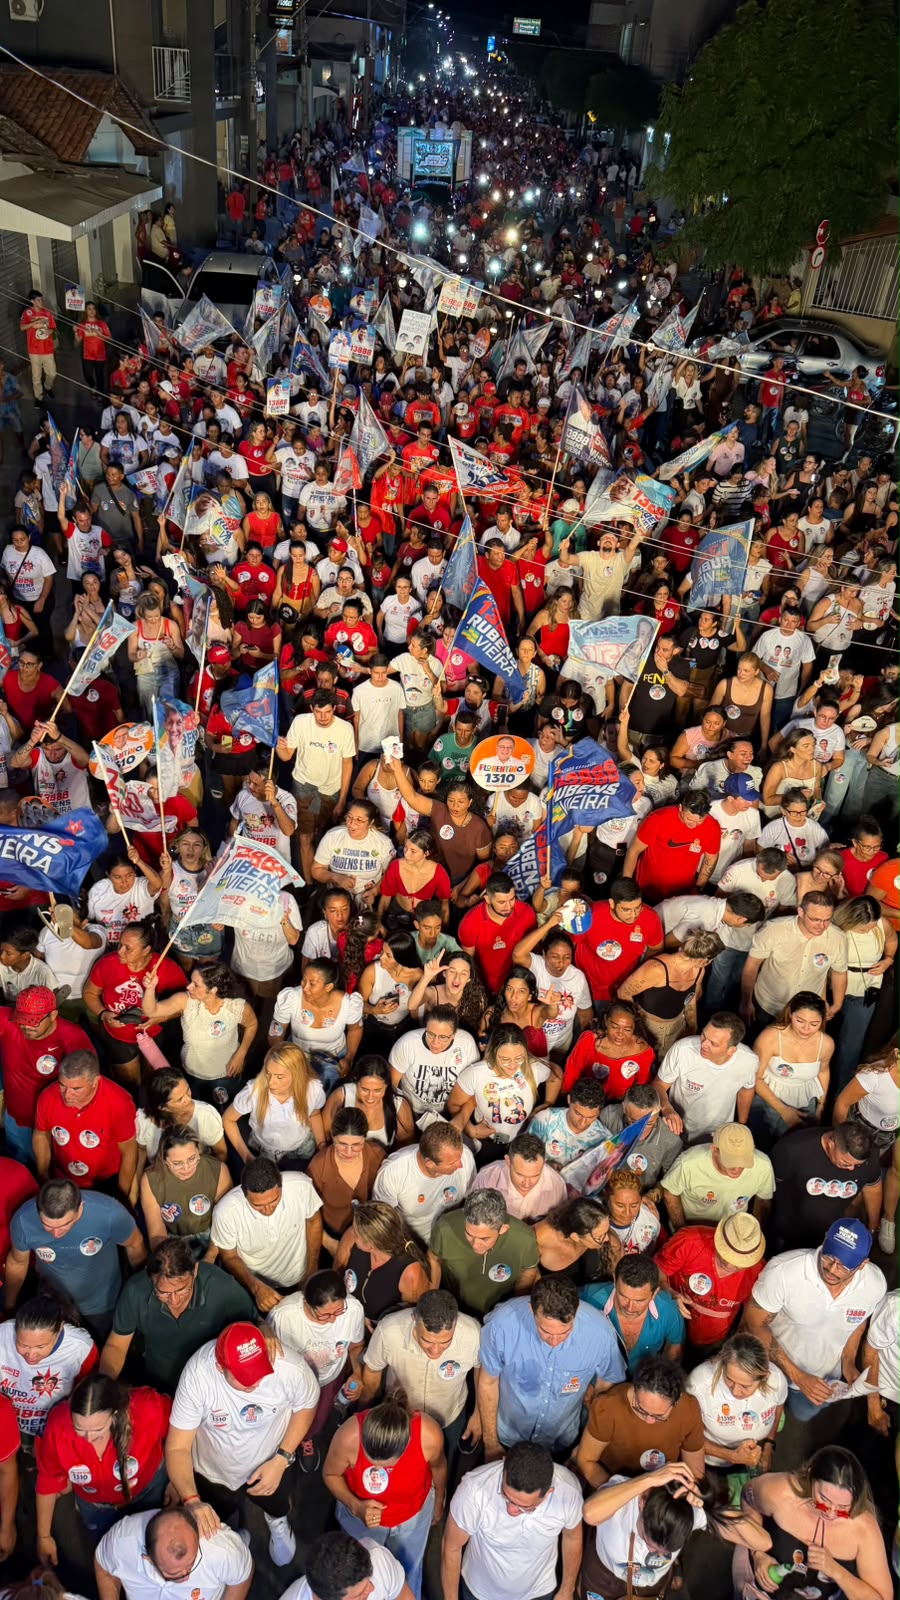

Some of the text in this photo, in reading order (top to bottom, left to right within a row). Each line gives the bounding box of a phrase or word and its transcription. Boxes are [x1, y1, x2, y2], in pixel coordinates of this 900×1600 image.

[475, 635, 515, 678] VIEIRA
[478, 763, 525, 773] FLORENTINO
[485, 773, 516, 784] 1310
